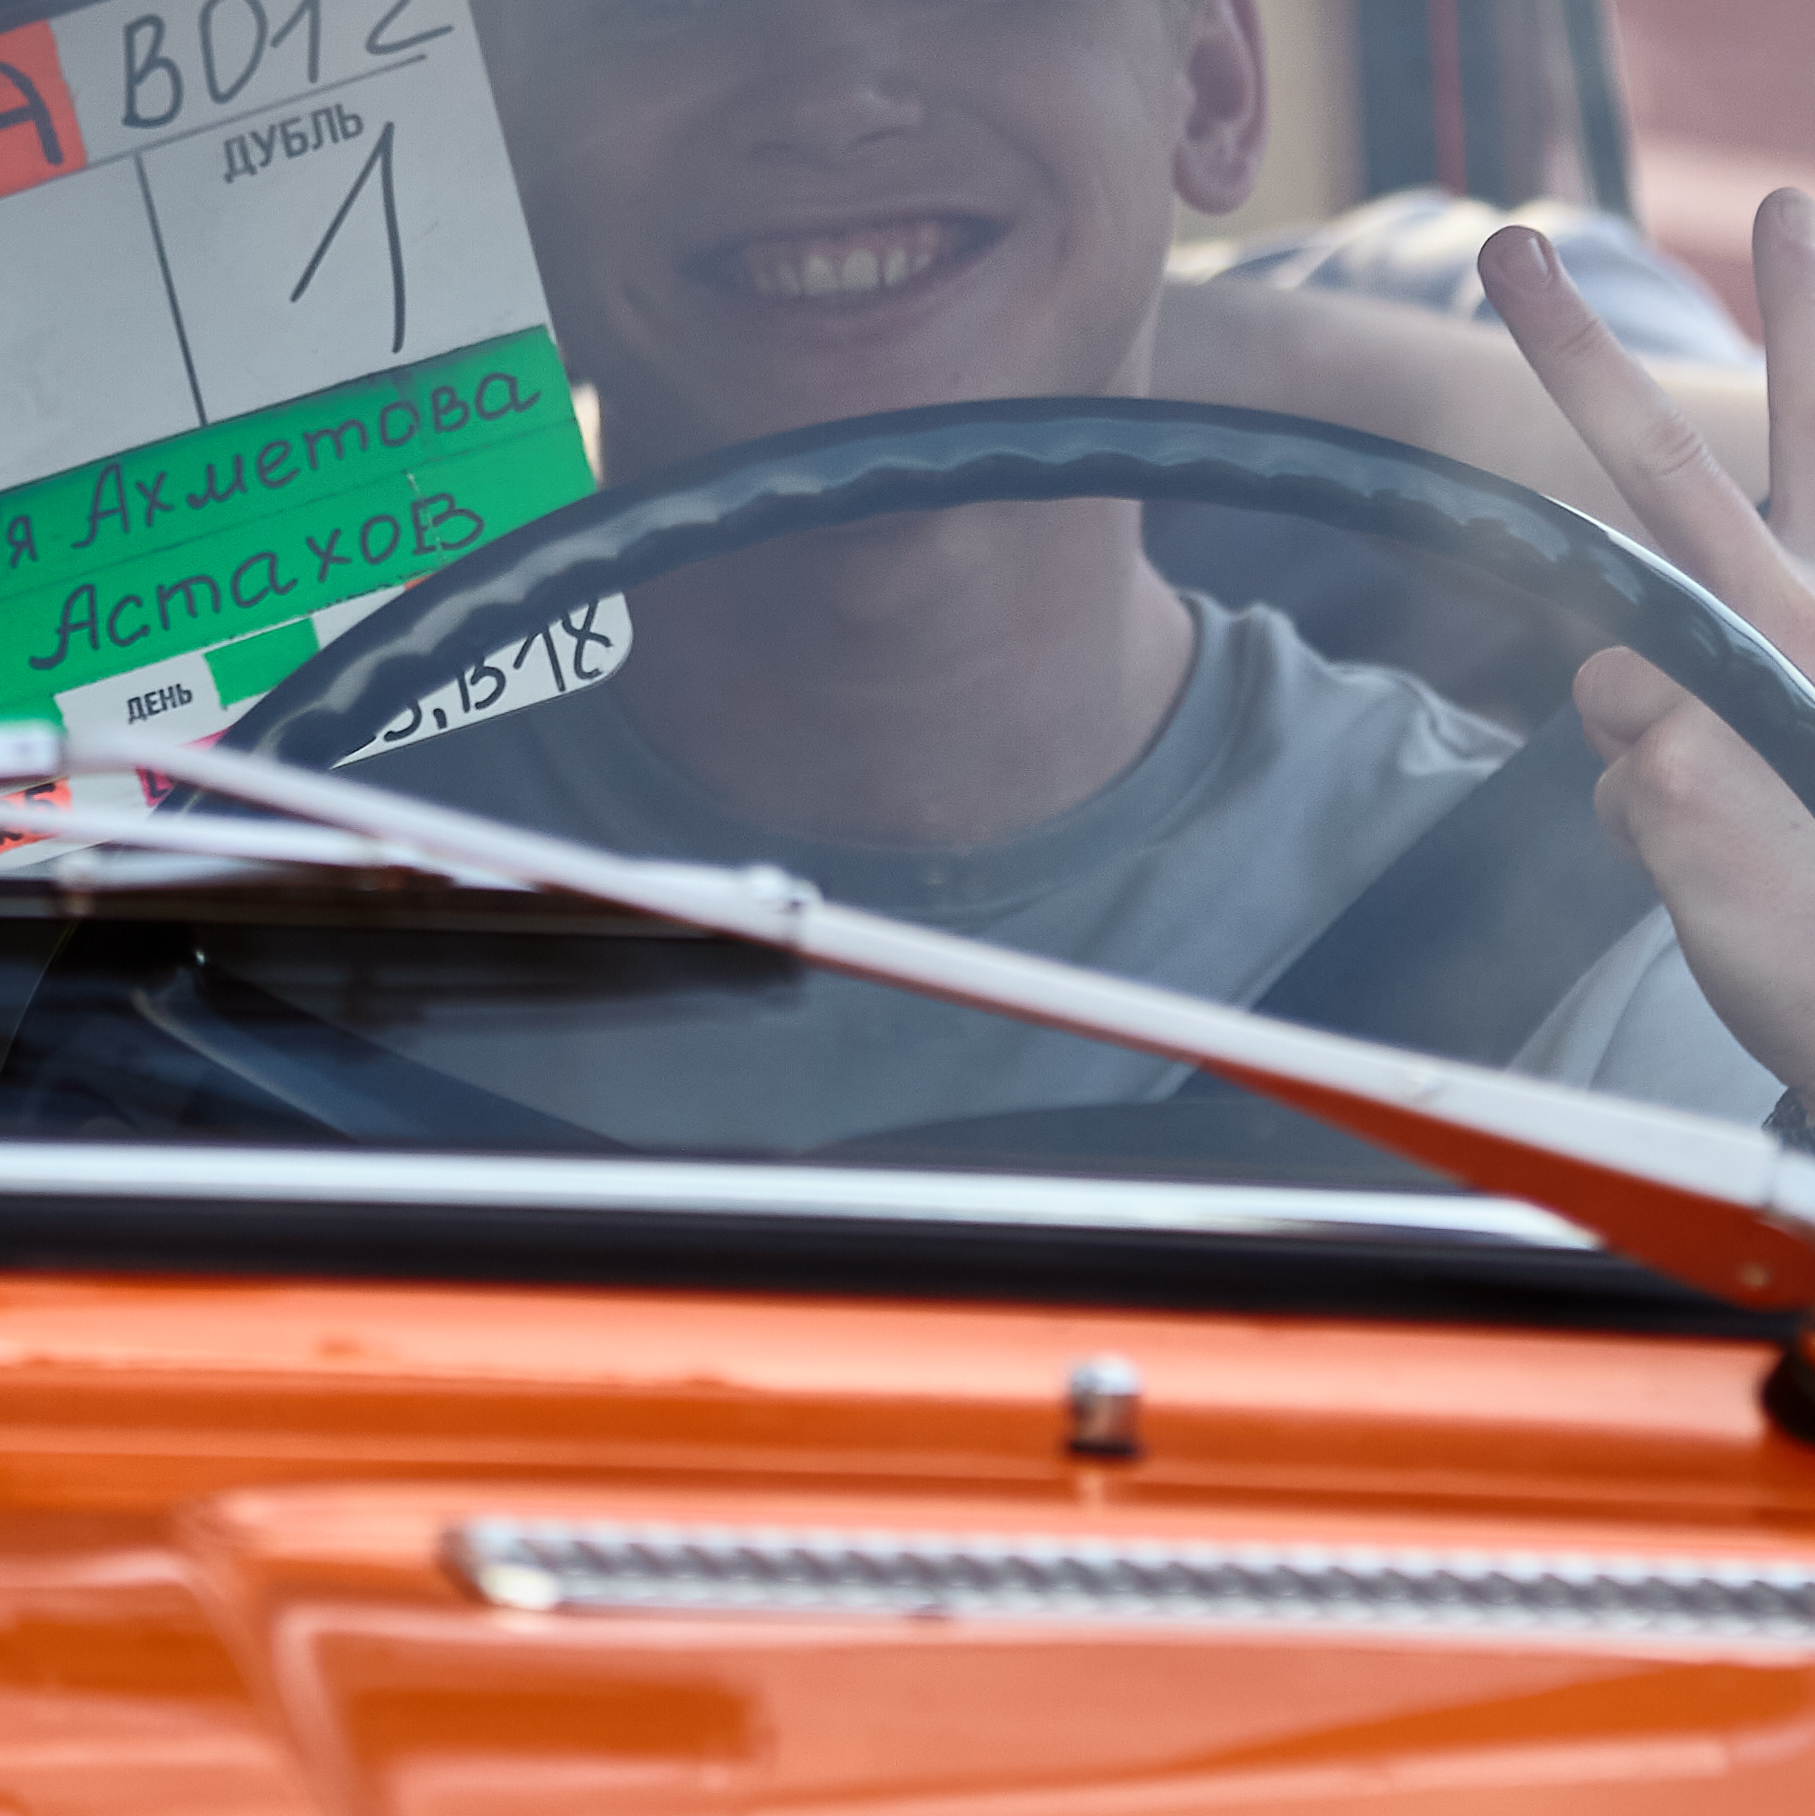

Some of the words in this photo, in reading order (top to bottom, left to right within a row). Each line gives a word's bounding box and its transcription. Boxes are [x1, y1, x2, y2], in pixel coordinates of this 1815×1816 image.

[222, 101, 365, 183] ДУБЛЬ
[289, 121, 406, 354] 1
[70, 370, 542, 549] Ахметова
[126, 682, 193, 725] ДЕНЬ
